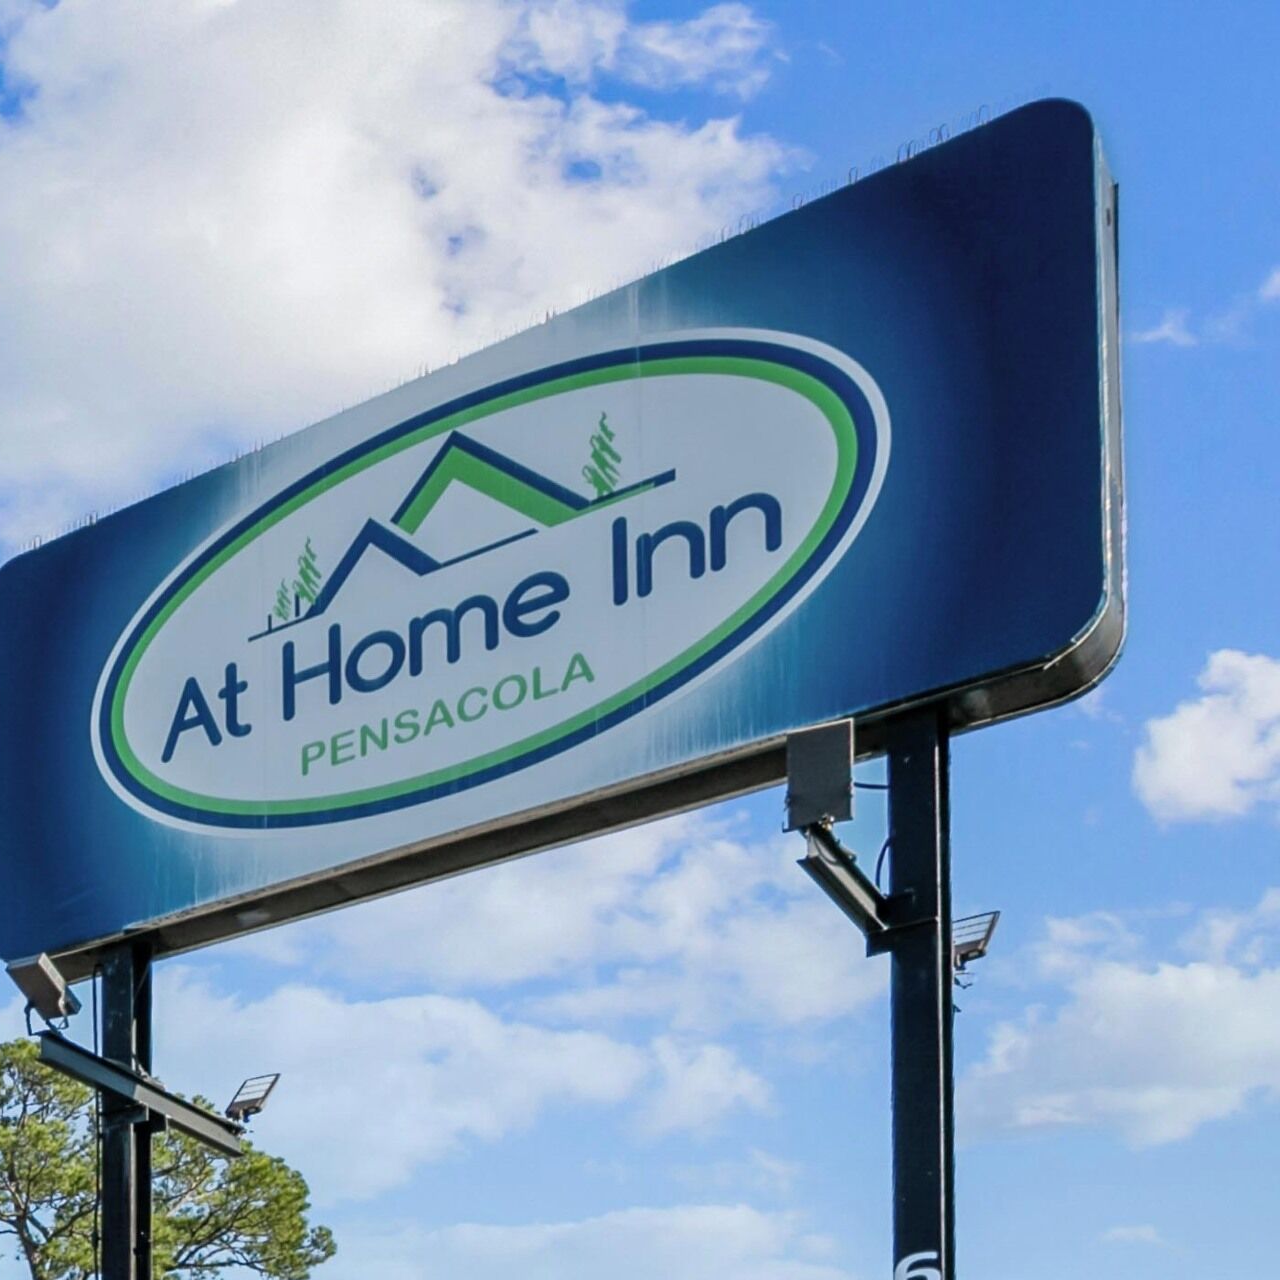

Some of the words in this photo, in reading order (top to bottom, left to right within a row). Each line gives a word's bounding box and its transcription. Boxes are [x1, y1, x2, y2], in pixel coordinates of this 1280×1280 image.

[161, 662, 252, 763] At
[282, 571, 571, 721] Home
[612, 492, 783, 606] Inn
[301, 652, 596, 776] PENSACOLA
